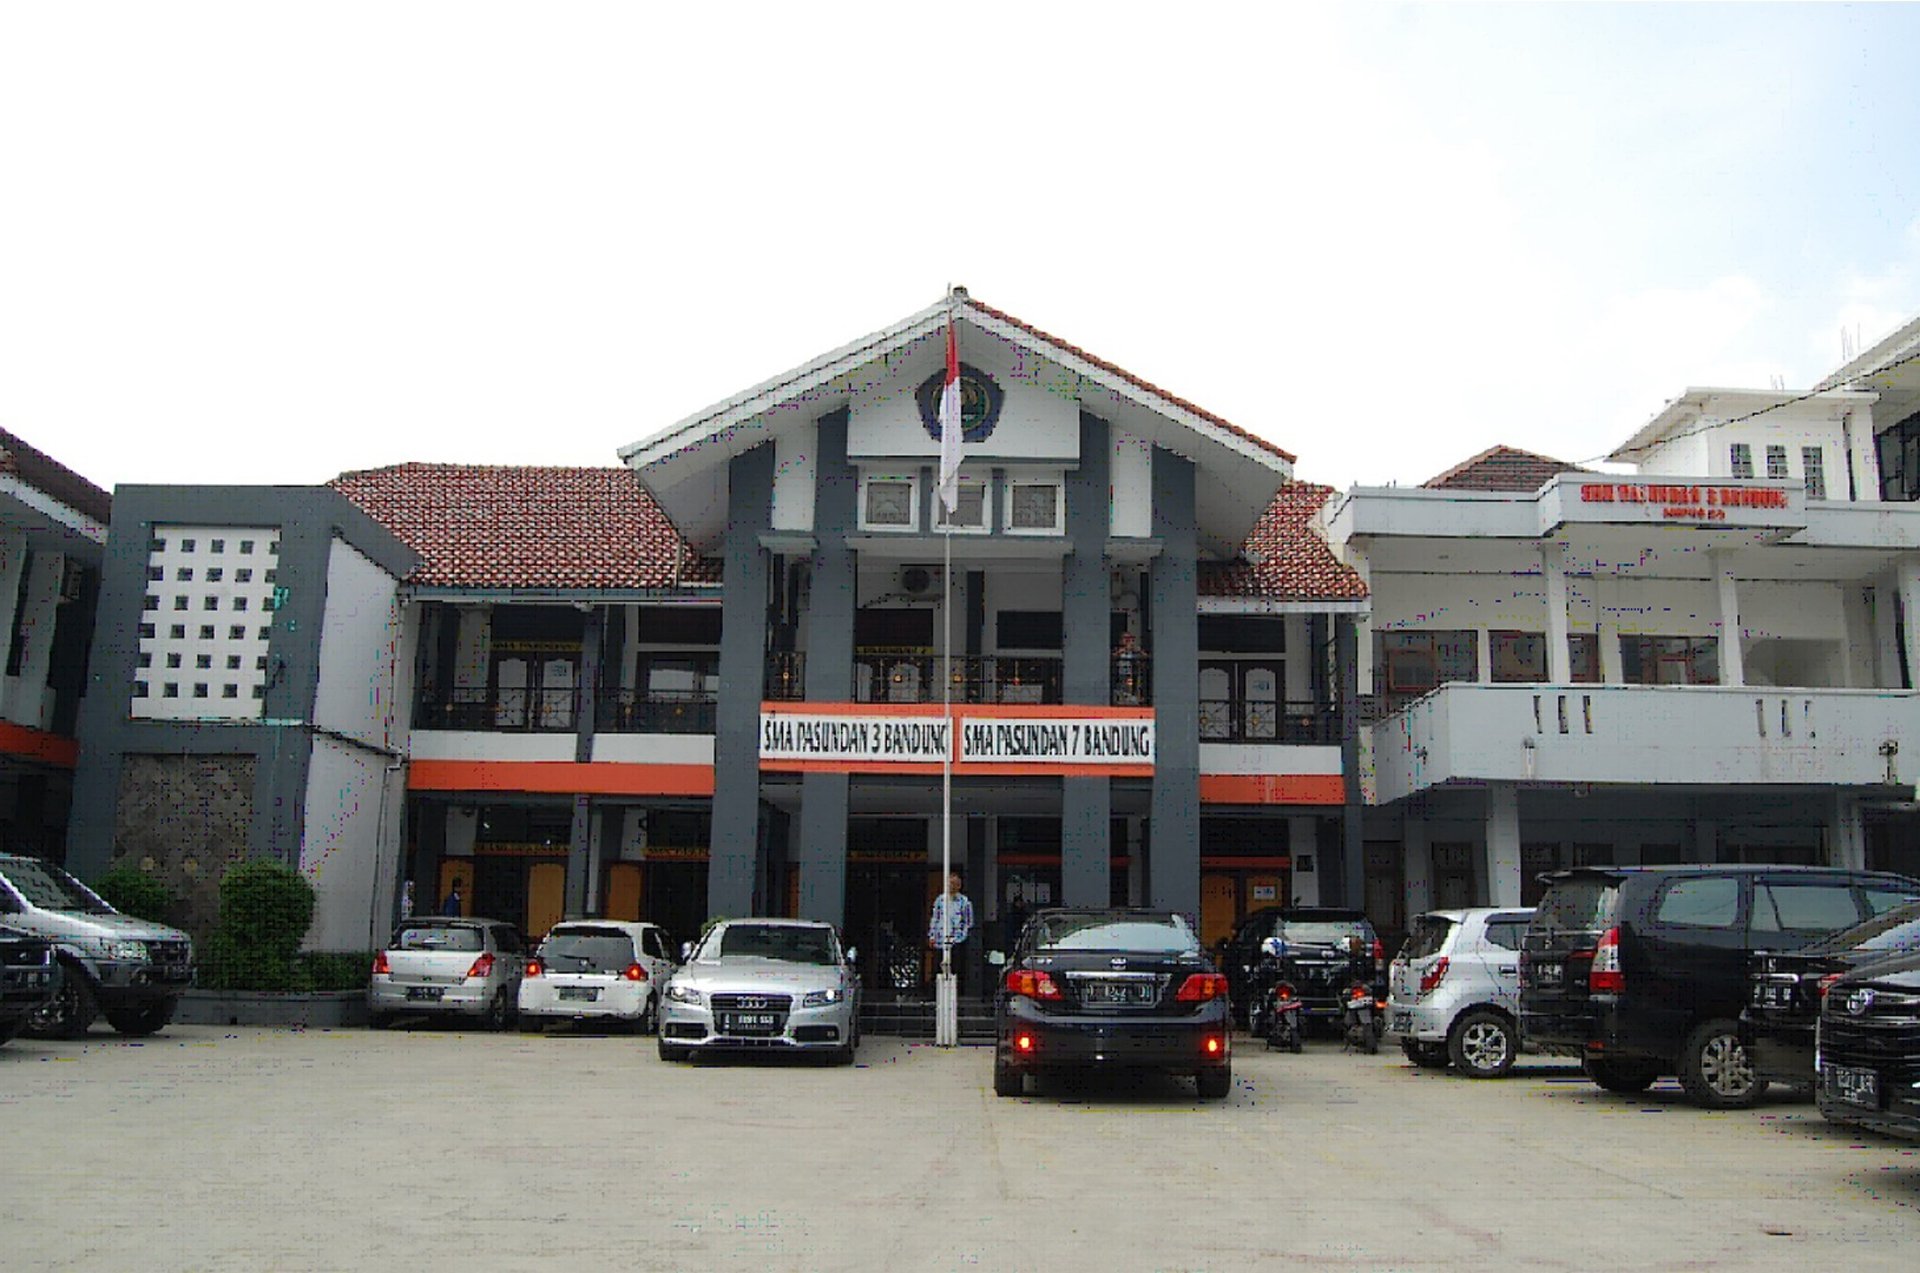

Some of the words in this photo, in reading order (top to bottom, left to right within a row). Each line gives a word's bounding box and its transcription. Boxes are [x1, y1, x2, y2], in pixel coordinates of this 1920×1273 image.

[764, 719, 793, 751] SMA
[796, 721, 868, 754] PASUNDAN
[871, 723, 881, 754] 3
[964, 724, 994, 755] SMA
[996, 724, 1068, 756] PASUNDAN
[1072, 725, 1081, 756] 7
[1084, 725, 1150, 757] BANDUNG
